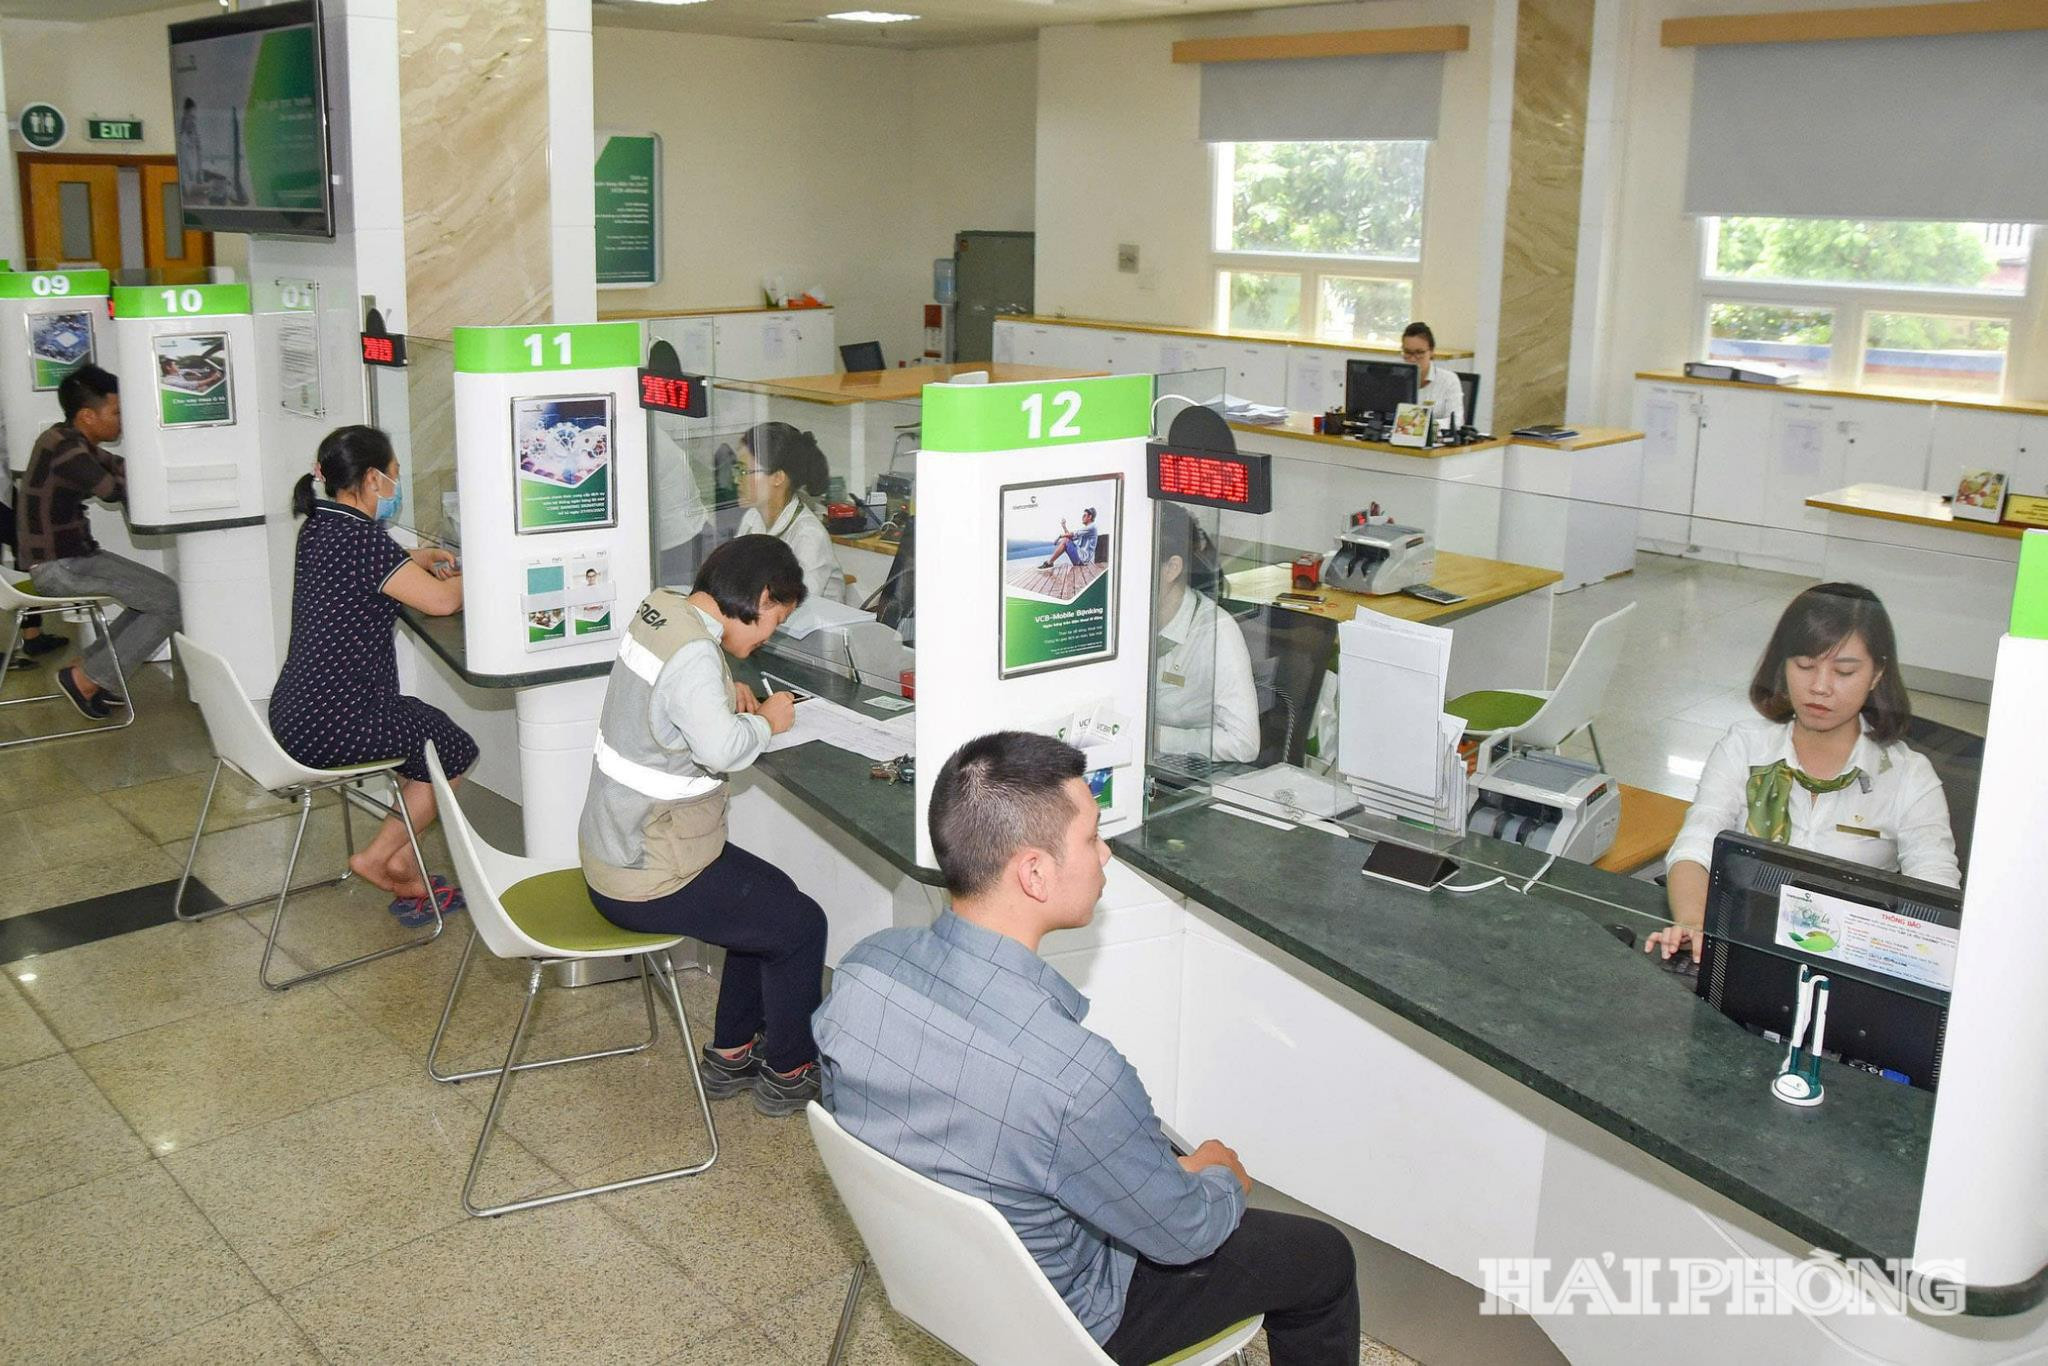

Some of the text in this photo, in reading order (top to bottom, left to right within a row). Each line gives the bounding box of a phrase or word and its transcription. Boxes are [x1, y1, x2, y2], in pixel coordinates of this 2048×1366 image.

[100, 122, 132, 139] EXIT
[31, 275, 71, 296] 09
[160, 289, 204, 313] 10
[523, 332, 572, 367] 11
[1021, 390, 1082, 440] 12
[1159, 453, 1249, 503] 1053
